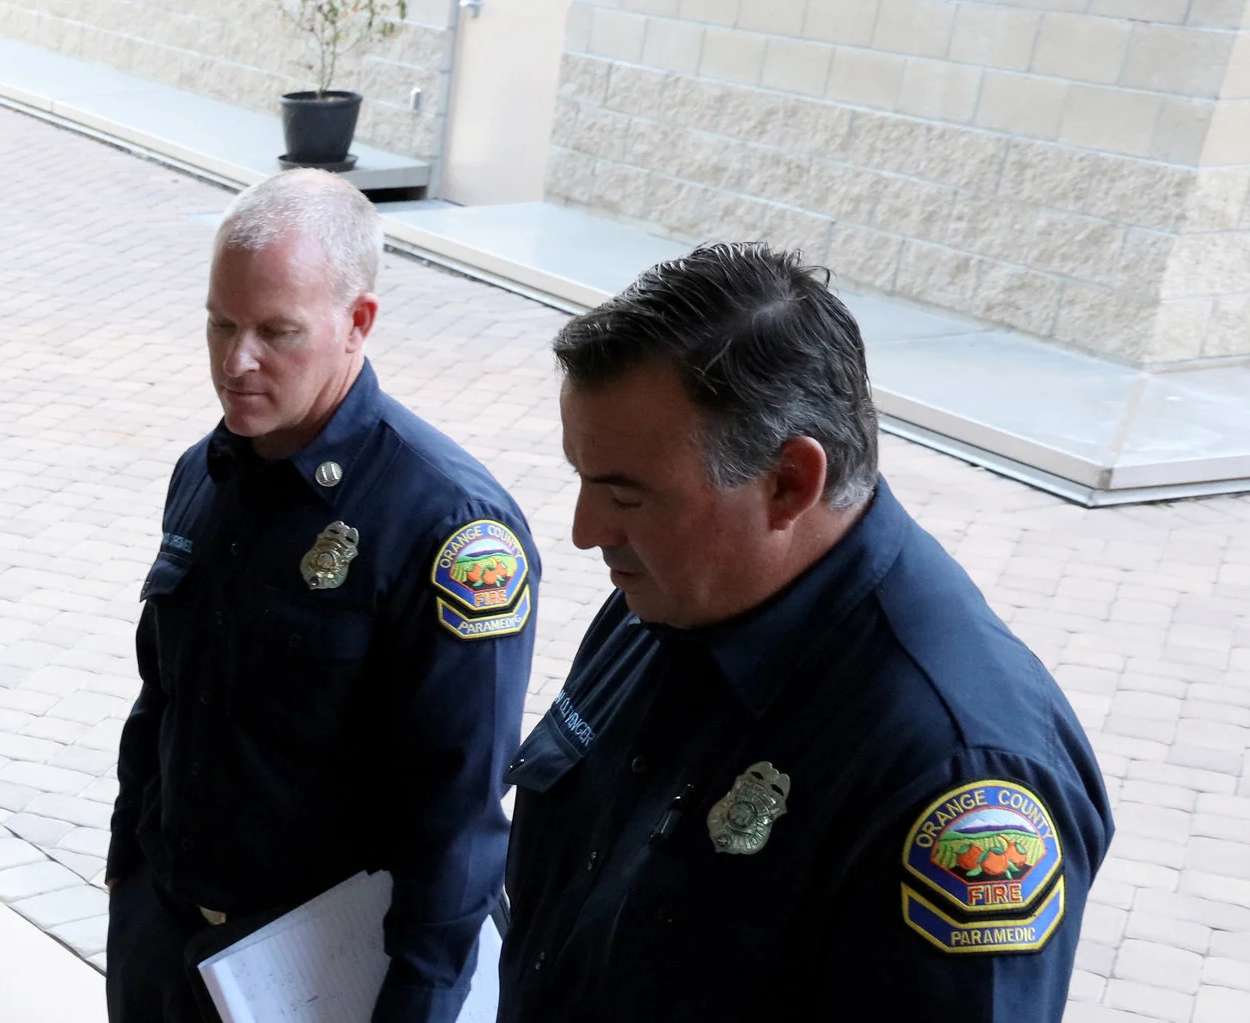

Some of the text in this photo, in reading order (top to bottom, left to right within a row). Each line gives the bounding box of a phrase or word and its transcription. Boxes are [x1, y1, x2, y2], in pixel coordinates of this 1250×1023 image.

[439, 525, 523, 569] ORANGE COUNTY
[474, 589, 507, 607] FIRE
[458, 614, 522, 635] PARAMEDIC
[916, 789, 1055, 849] ORANGE COUNTY
[967, 884, 1023, 905] FIRE
[950, 927, 1036, 946] PARAMEDIC
